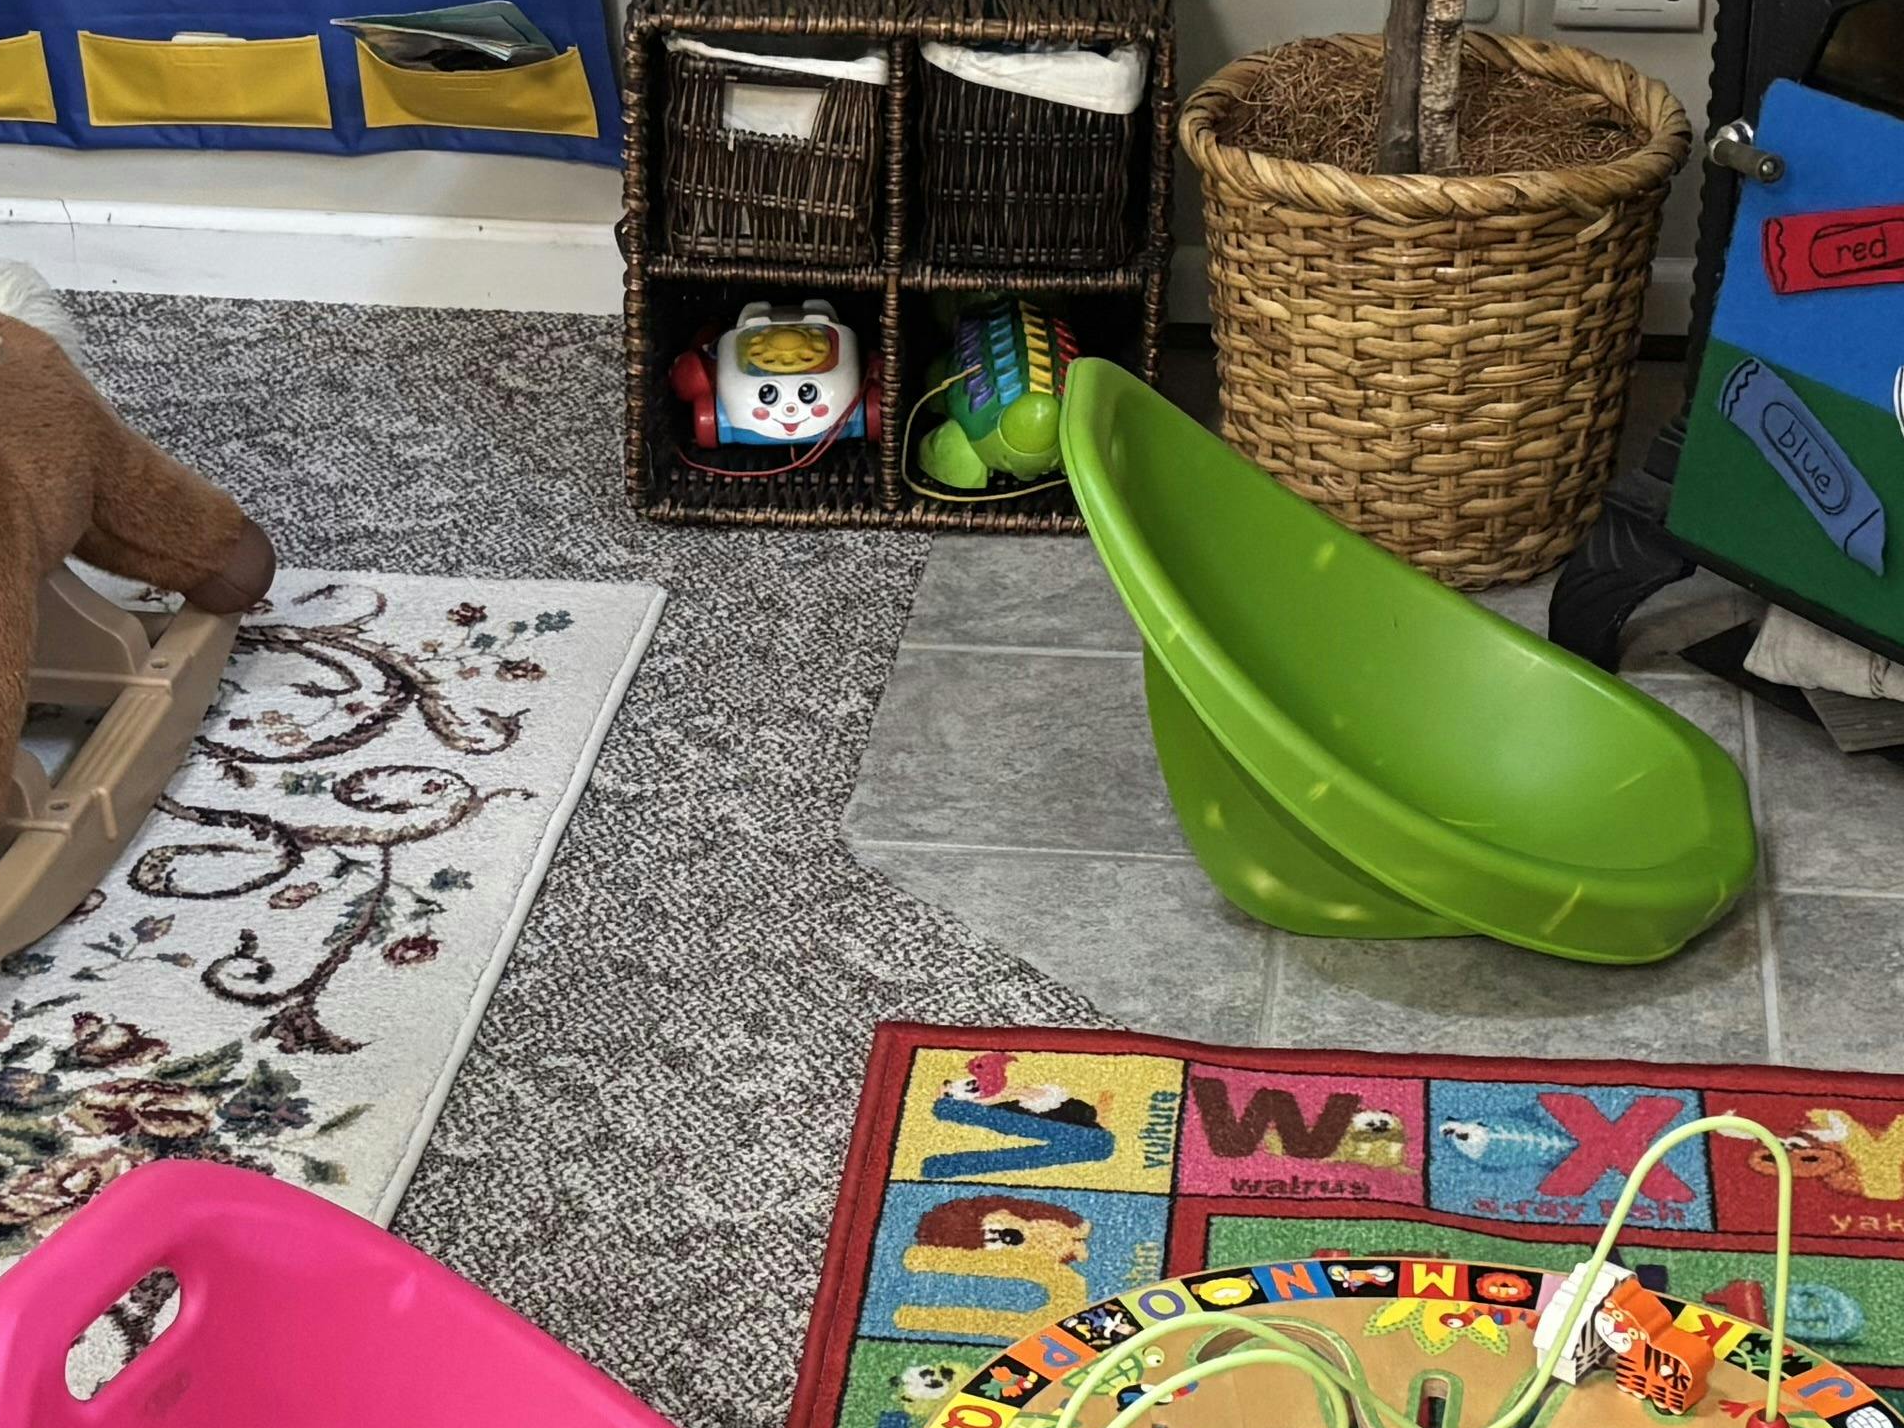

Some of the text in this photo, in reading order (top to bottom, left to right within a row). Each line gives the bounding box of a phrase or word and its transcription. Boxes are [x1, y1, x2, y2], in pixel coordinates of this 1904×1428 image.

[1836, 231, 1888, 262] red
[1779, 422, 1833, 495] blue
[1137, 1089, 1180, 1171] vulture
[1194, 1076, 1361, 1159] W
[1537, 1091, 1698, 1203] X
[1229, 1175, 1372, 1198] walrus
[1269, 1263, 1319, 1301] N
[1137, 1288, 1187, 1321] O
[1039, 1334, 1083, 1368] P
[1797, 1376, 1856, 1399] J
